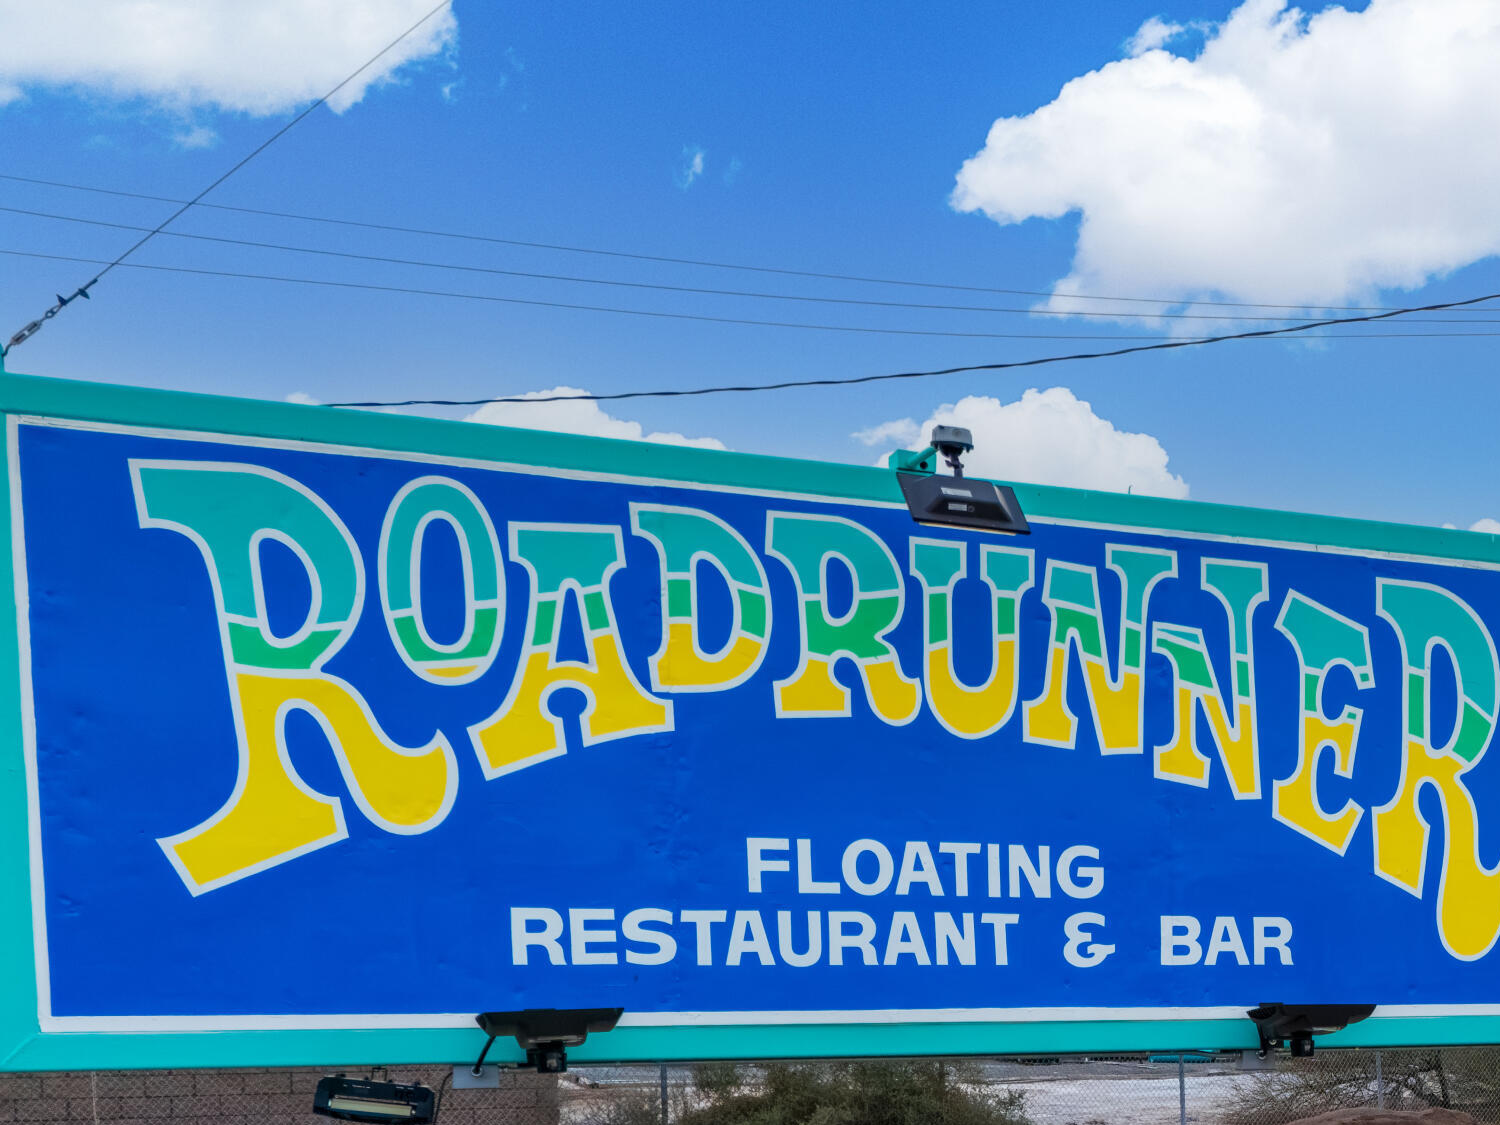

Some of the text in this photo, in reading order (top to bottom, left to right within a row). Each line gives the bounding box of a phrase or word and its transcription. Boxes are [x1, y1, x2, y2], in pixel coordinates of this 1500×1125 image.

[746, 837, 1104, 899] FLOATING
[510, 907, 1293, 968] RESTAURANT & BAR
